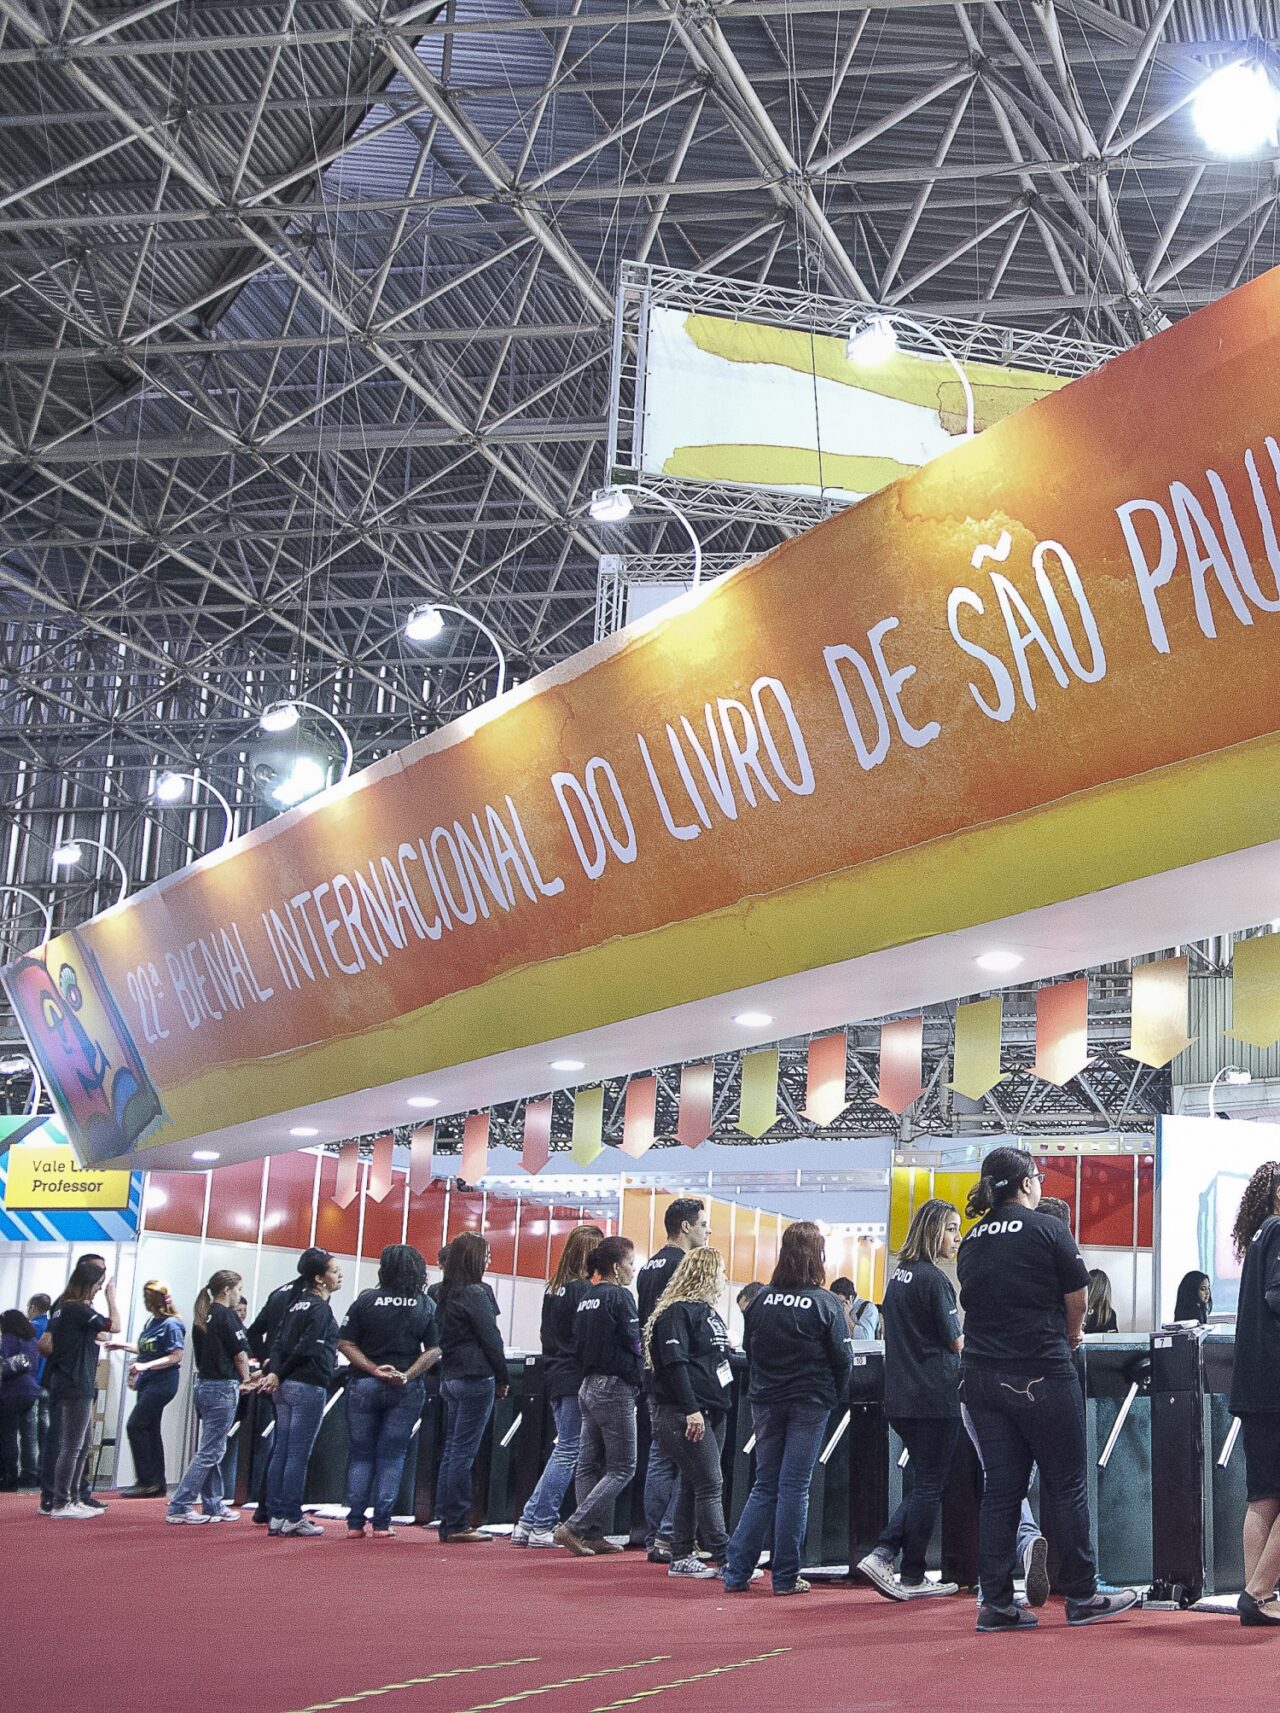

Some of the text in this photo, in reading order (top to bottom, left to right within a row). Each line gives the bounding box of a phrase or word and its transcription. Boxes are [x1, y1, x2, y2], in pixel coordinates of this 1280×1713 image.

[165, 922, 274, 1031] BIENAL
[262, 795, 563, 990] INTERNACIONAL
[551, 756, 638, 880] DO
[637, 676, 816, 840] LIVRO
[823, 616, 941, 771] DE
[947, 531, 1107, 723] SÃO
[33, 1160, 66, 1173] Vale
[32, 1179, 104, 1193] Professor
[966, 1220, 1023, 1240] APOIO
[641, 1258, 667, 1271] APOIO
[374, 1296, 417, 1307] APOIO
[576, 1298, 601, 1313] APOIO
[763, 1293, 813, 1309] APOIO
[1159, 1338, 1165, 1348] 7
[856, 1357, 864, 1365] 10
